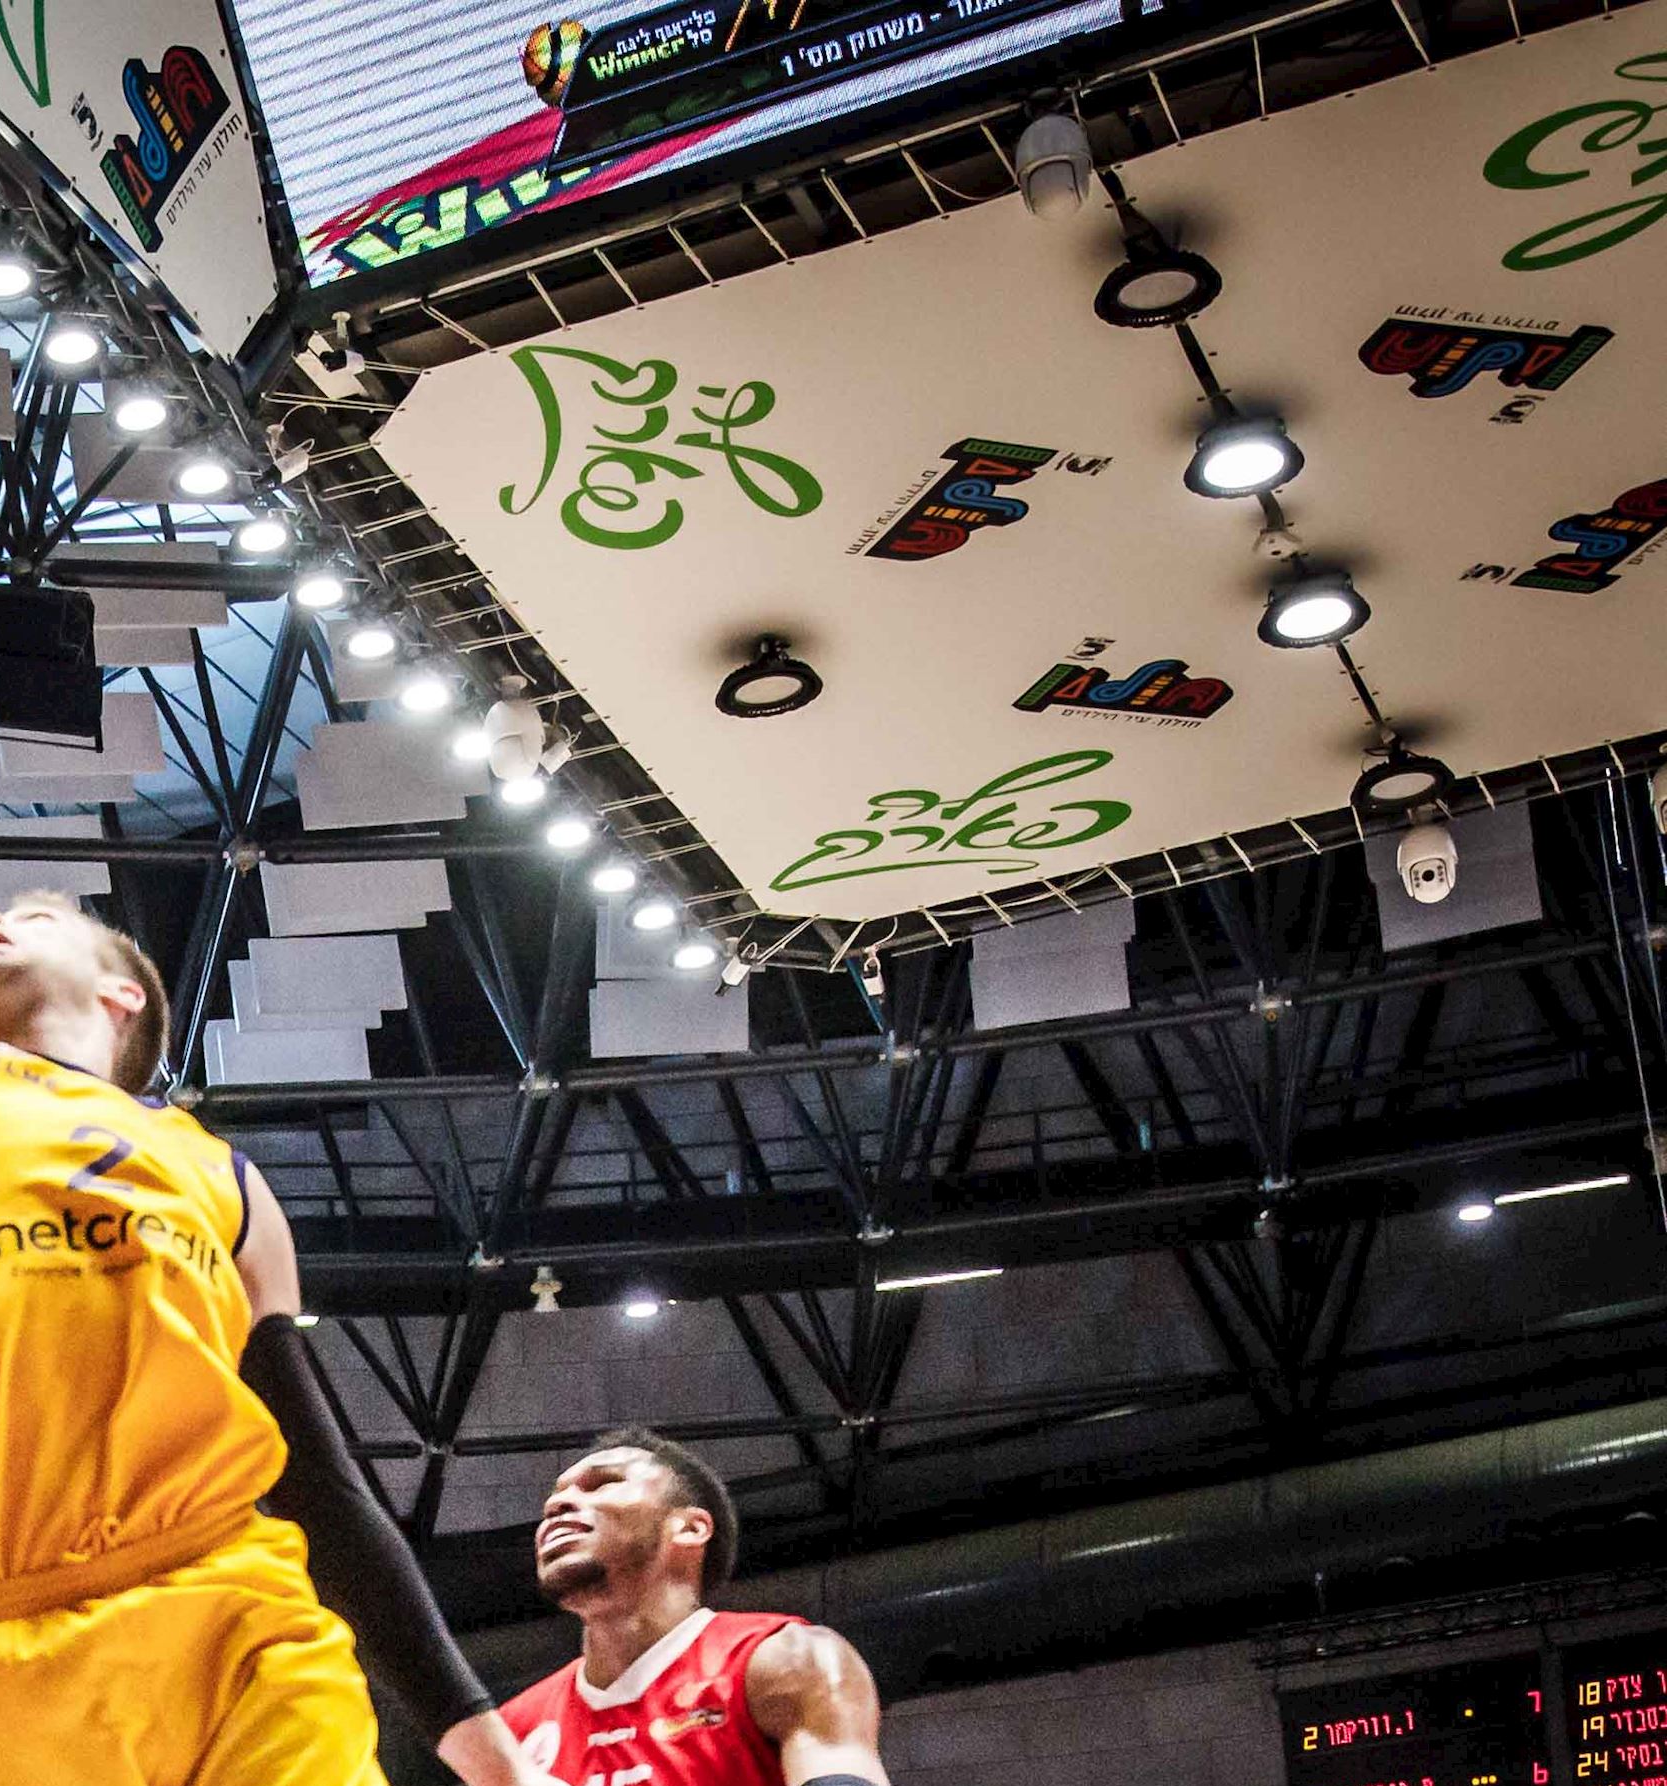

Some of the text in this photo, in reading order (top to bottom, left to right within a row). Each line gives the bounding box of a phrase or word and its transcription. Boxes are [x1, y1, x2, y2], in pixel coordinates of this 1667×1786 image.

[848, 11, 927, 60] משחק
[586, 36, 685, 82] Winner
[68, 1125, 134, 1194] 2
[1578, 1681, 1601, 1706] 18
[1303, 1726, 1318, 1750] 2
[1527, 1690, 1542, 1713] 7
[1582, 1715, 1605, 1741] 19
[1577, 1750, 1609, 1778] 24
